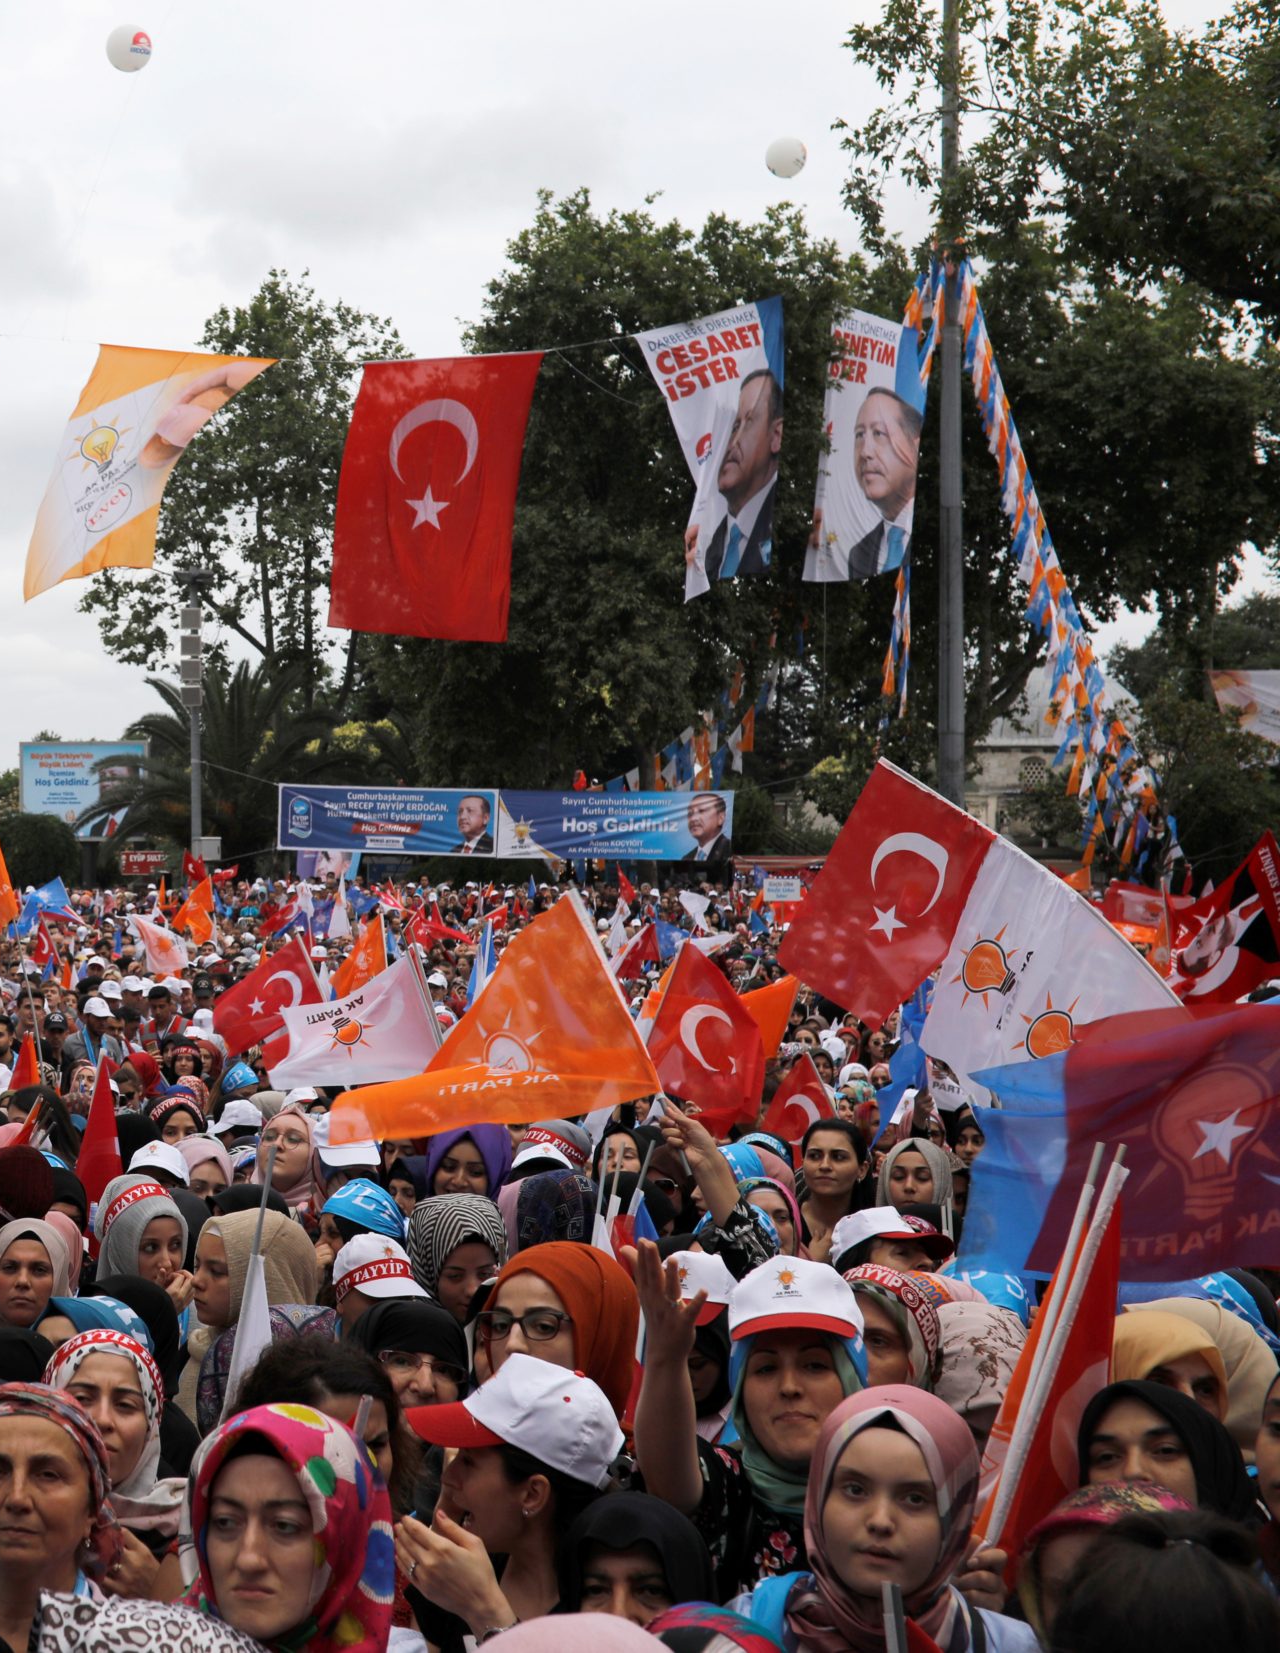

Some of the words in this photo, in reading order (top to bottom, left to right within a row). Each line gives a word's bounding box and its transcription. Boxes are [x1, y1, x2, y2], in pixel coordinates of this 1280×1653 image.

[647, 326, 704, 352] DARBELERE
[655, 322, 762, 375] CESARET
[662, 356, 740, 402] İSTER
[35, 778, 52, 787] Hoş
[54, 778, 89, 786] Geldiniz
[347, 791, 424, 801] Cumhurbaşkanımız
[562, 797, 586, 806] Sayın
[348, 802, 374, 810] RECEP
[376, 801, 405, 810] TAYYİP
[582, 807, 607, 815] Kutlu
[562, 818, 598, 836] Hoş
[603, 818, 679, 833] Geldiniz
[345, 995, 364, 1011] AK
[306, 1007, 343, 1025] PARTİ
[113, 1182, 156, 1212] TAYYİP
[352, 1260, 404, 1283] TAYYİP
